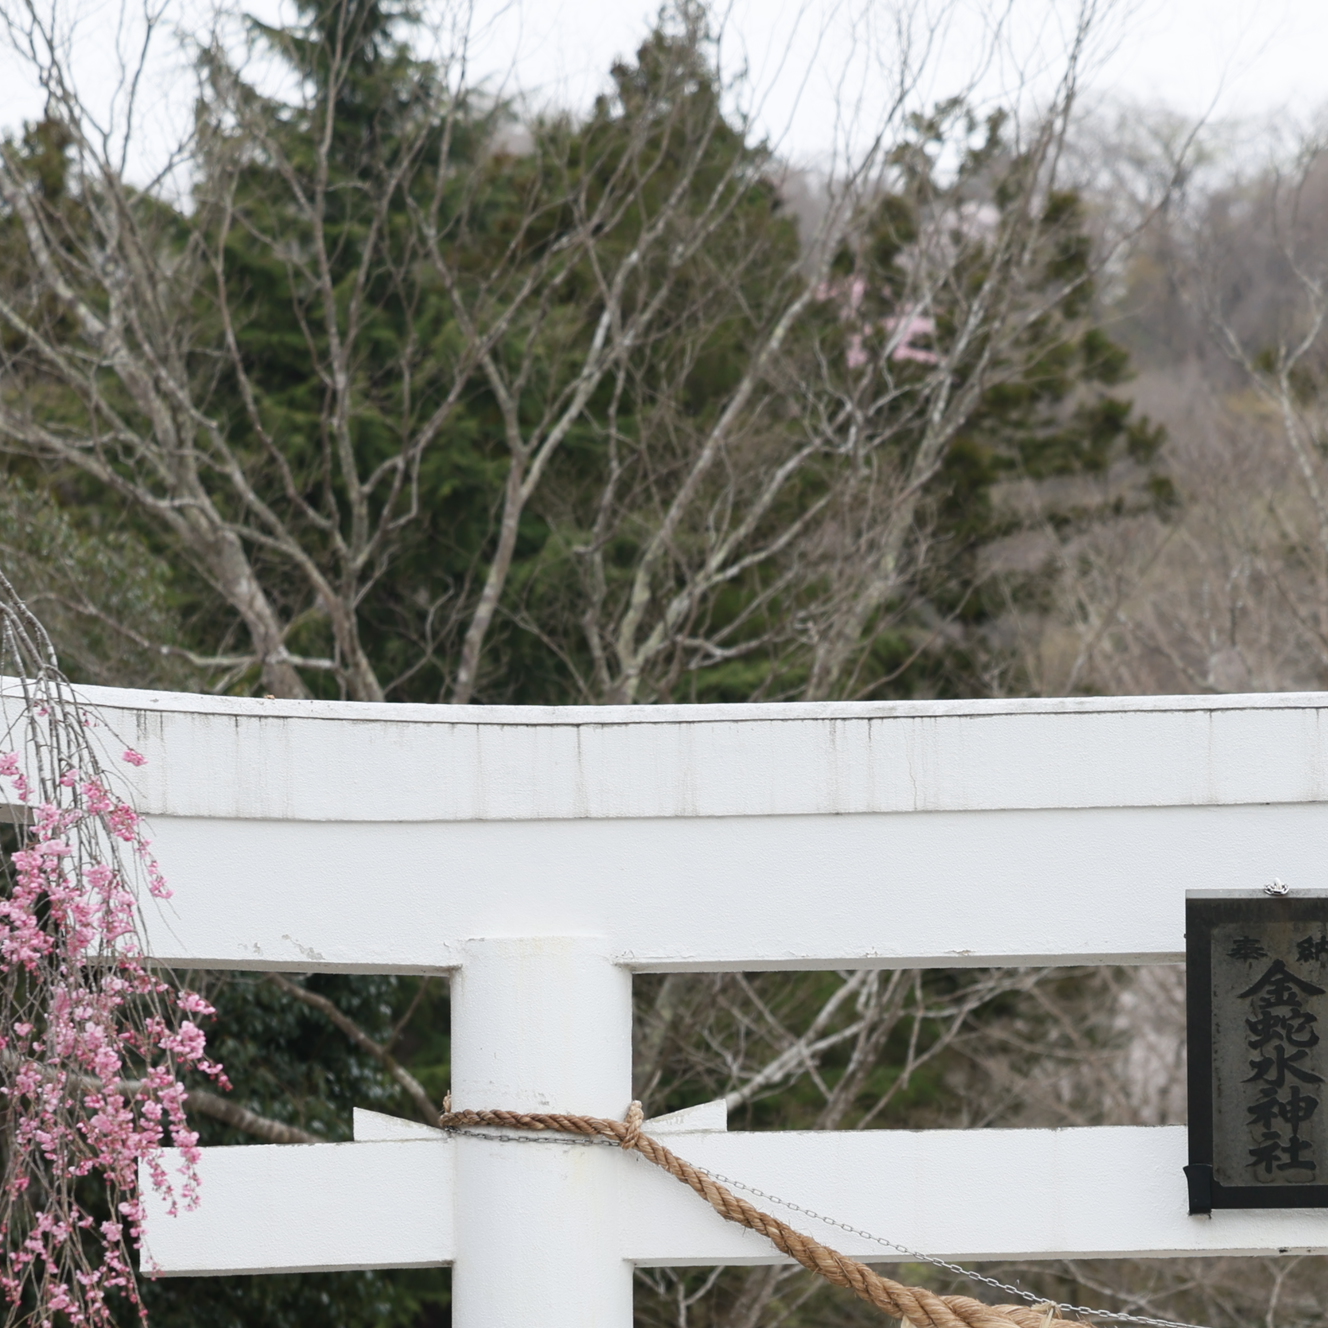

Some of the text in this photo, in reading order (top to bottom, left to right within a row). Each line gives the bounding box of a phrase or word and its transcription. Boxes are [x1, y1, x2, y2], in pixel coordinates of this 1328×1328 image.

[1236, 958, 1327, 1174] 金蛇水神社
